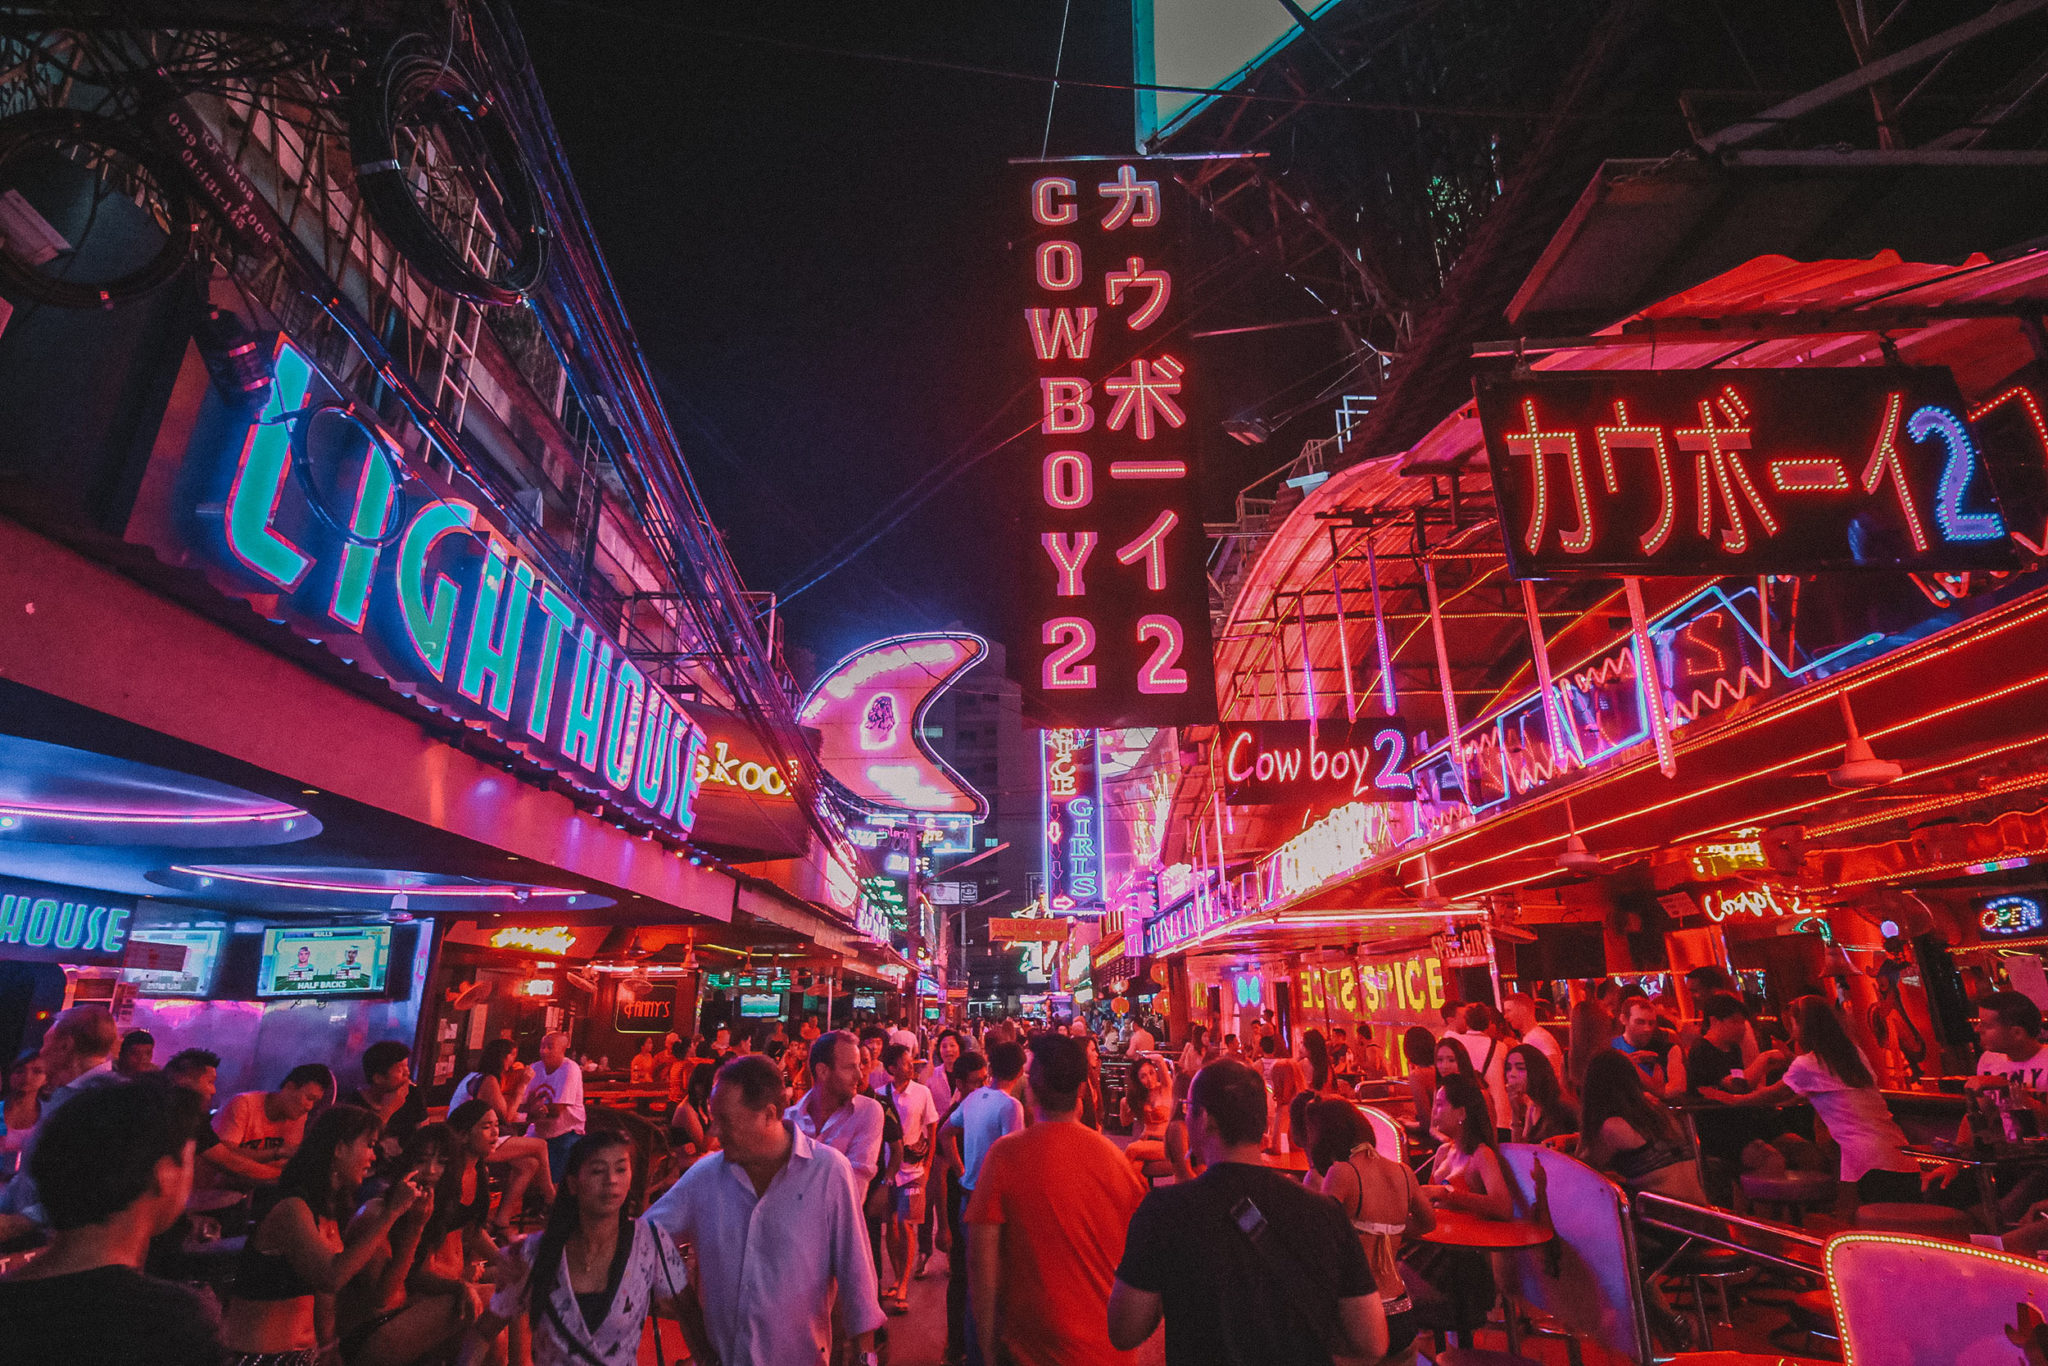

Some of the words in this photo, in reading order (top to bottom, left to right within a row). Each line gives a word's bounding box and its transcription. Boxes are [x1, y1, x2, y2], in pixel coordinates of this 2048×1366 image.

[225, 331, 708, 834] LIGHTHOUSE
[1068, 798, 1098, 897] GIRLS
[0, 894, 131, 952] HOUSE
[1982, 906, 2042, 929] OPEN
[297, 982, 319, 990] HALF
[319, 980, 347, 989] BACKS
[1361, 957, 1446, 1013] SPICE
